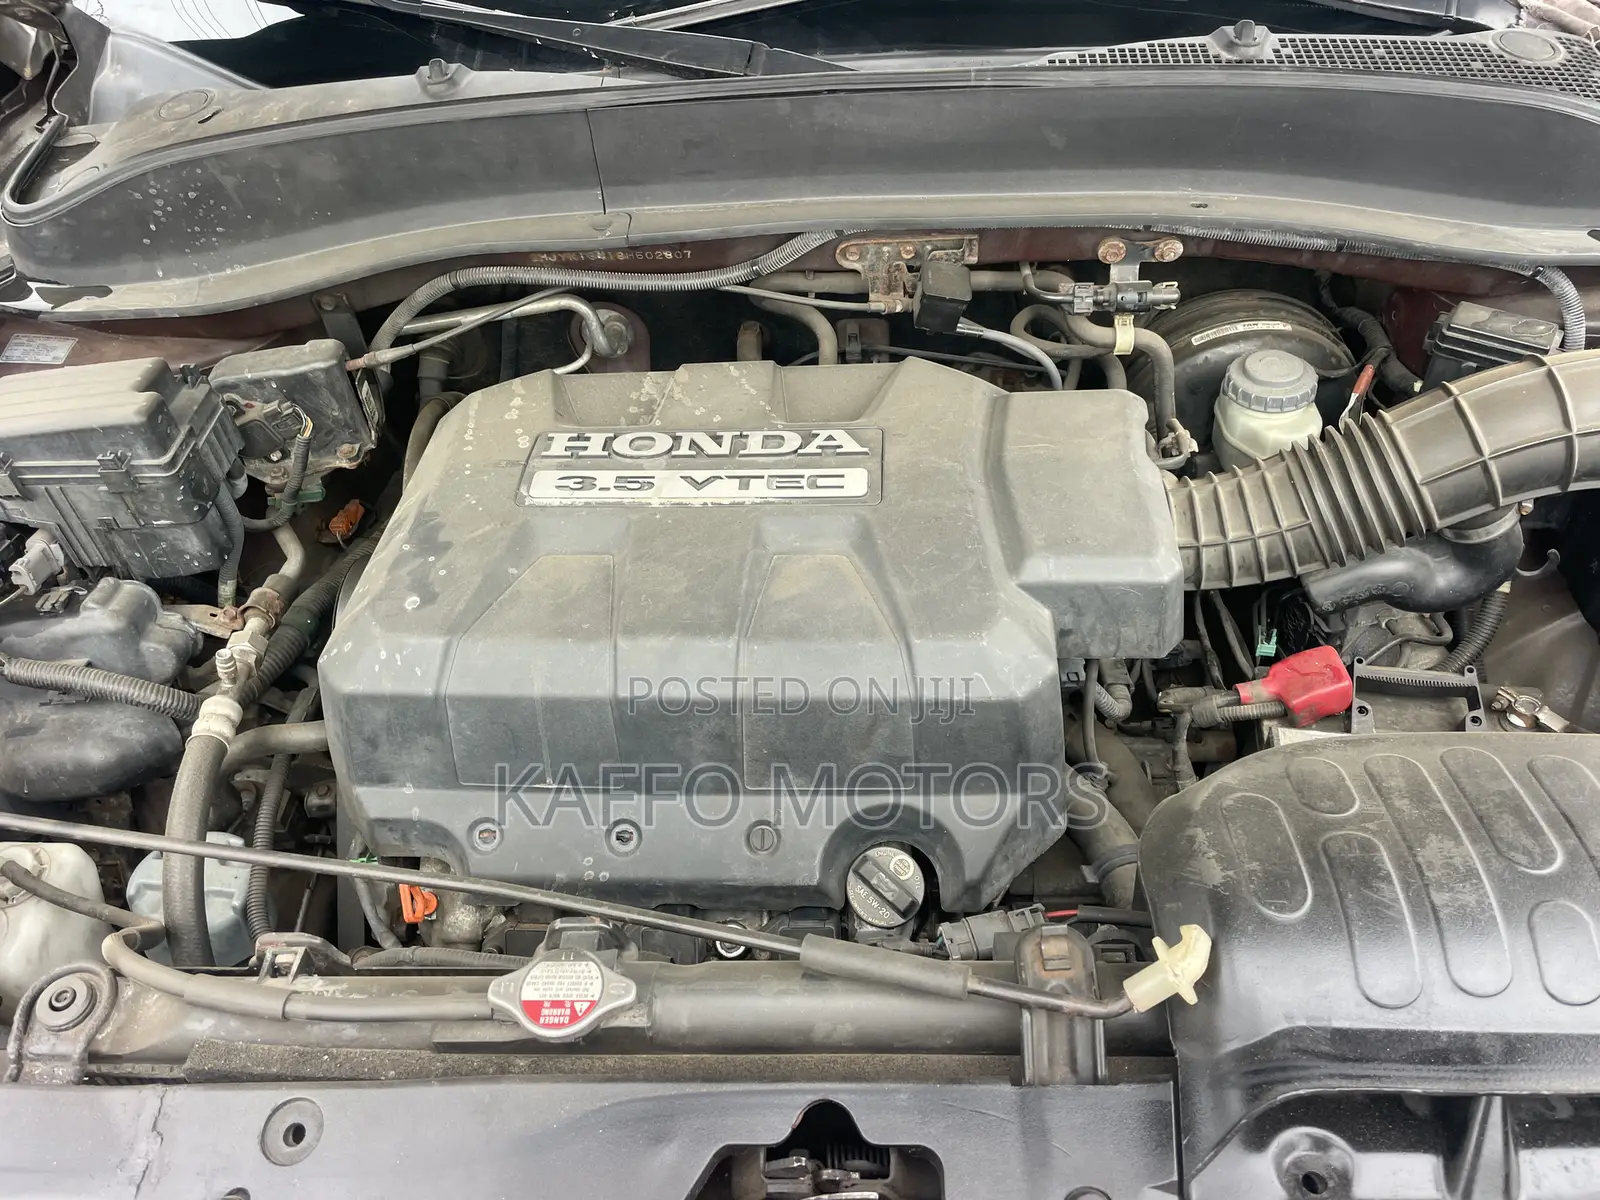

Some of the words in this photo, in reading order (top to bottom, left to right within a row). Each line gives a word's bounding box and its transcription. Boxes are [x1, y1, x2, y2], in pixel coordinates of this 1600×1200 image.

[541, 430, 870, 459] HONDA
[555, 475, 656, 491] 3.5
[680, 474, 845, 491] VTEC
[874, 850, 896, 858] ENGINE
[855, 885, 869, 899] SAE
[867, 896, 890, 919] 5W-20
[540, 1008, 571, 1016] WARNING
[539, 1015, 570, 1024] DANGER
